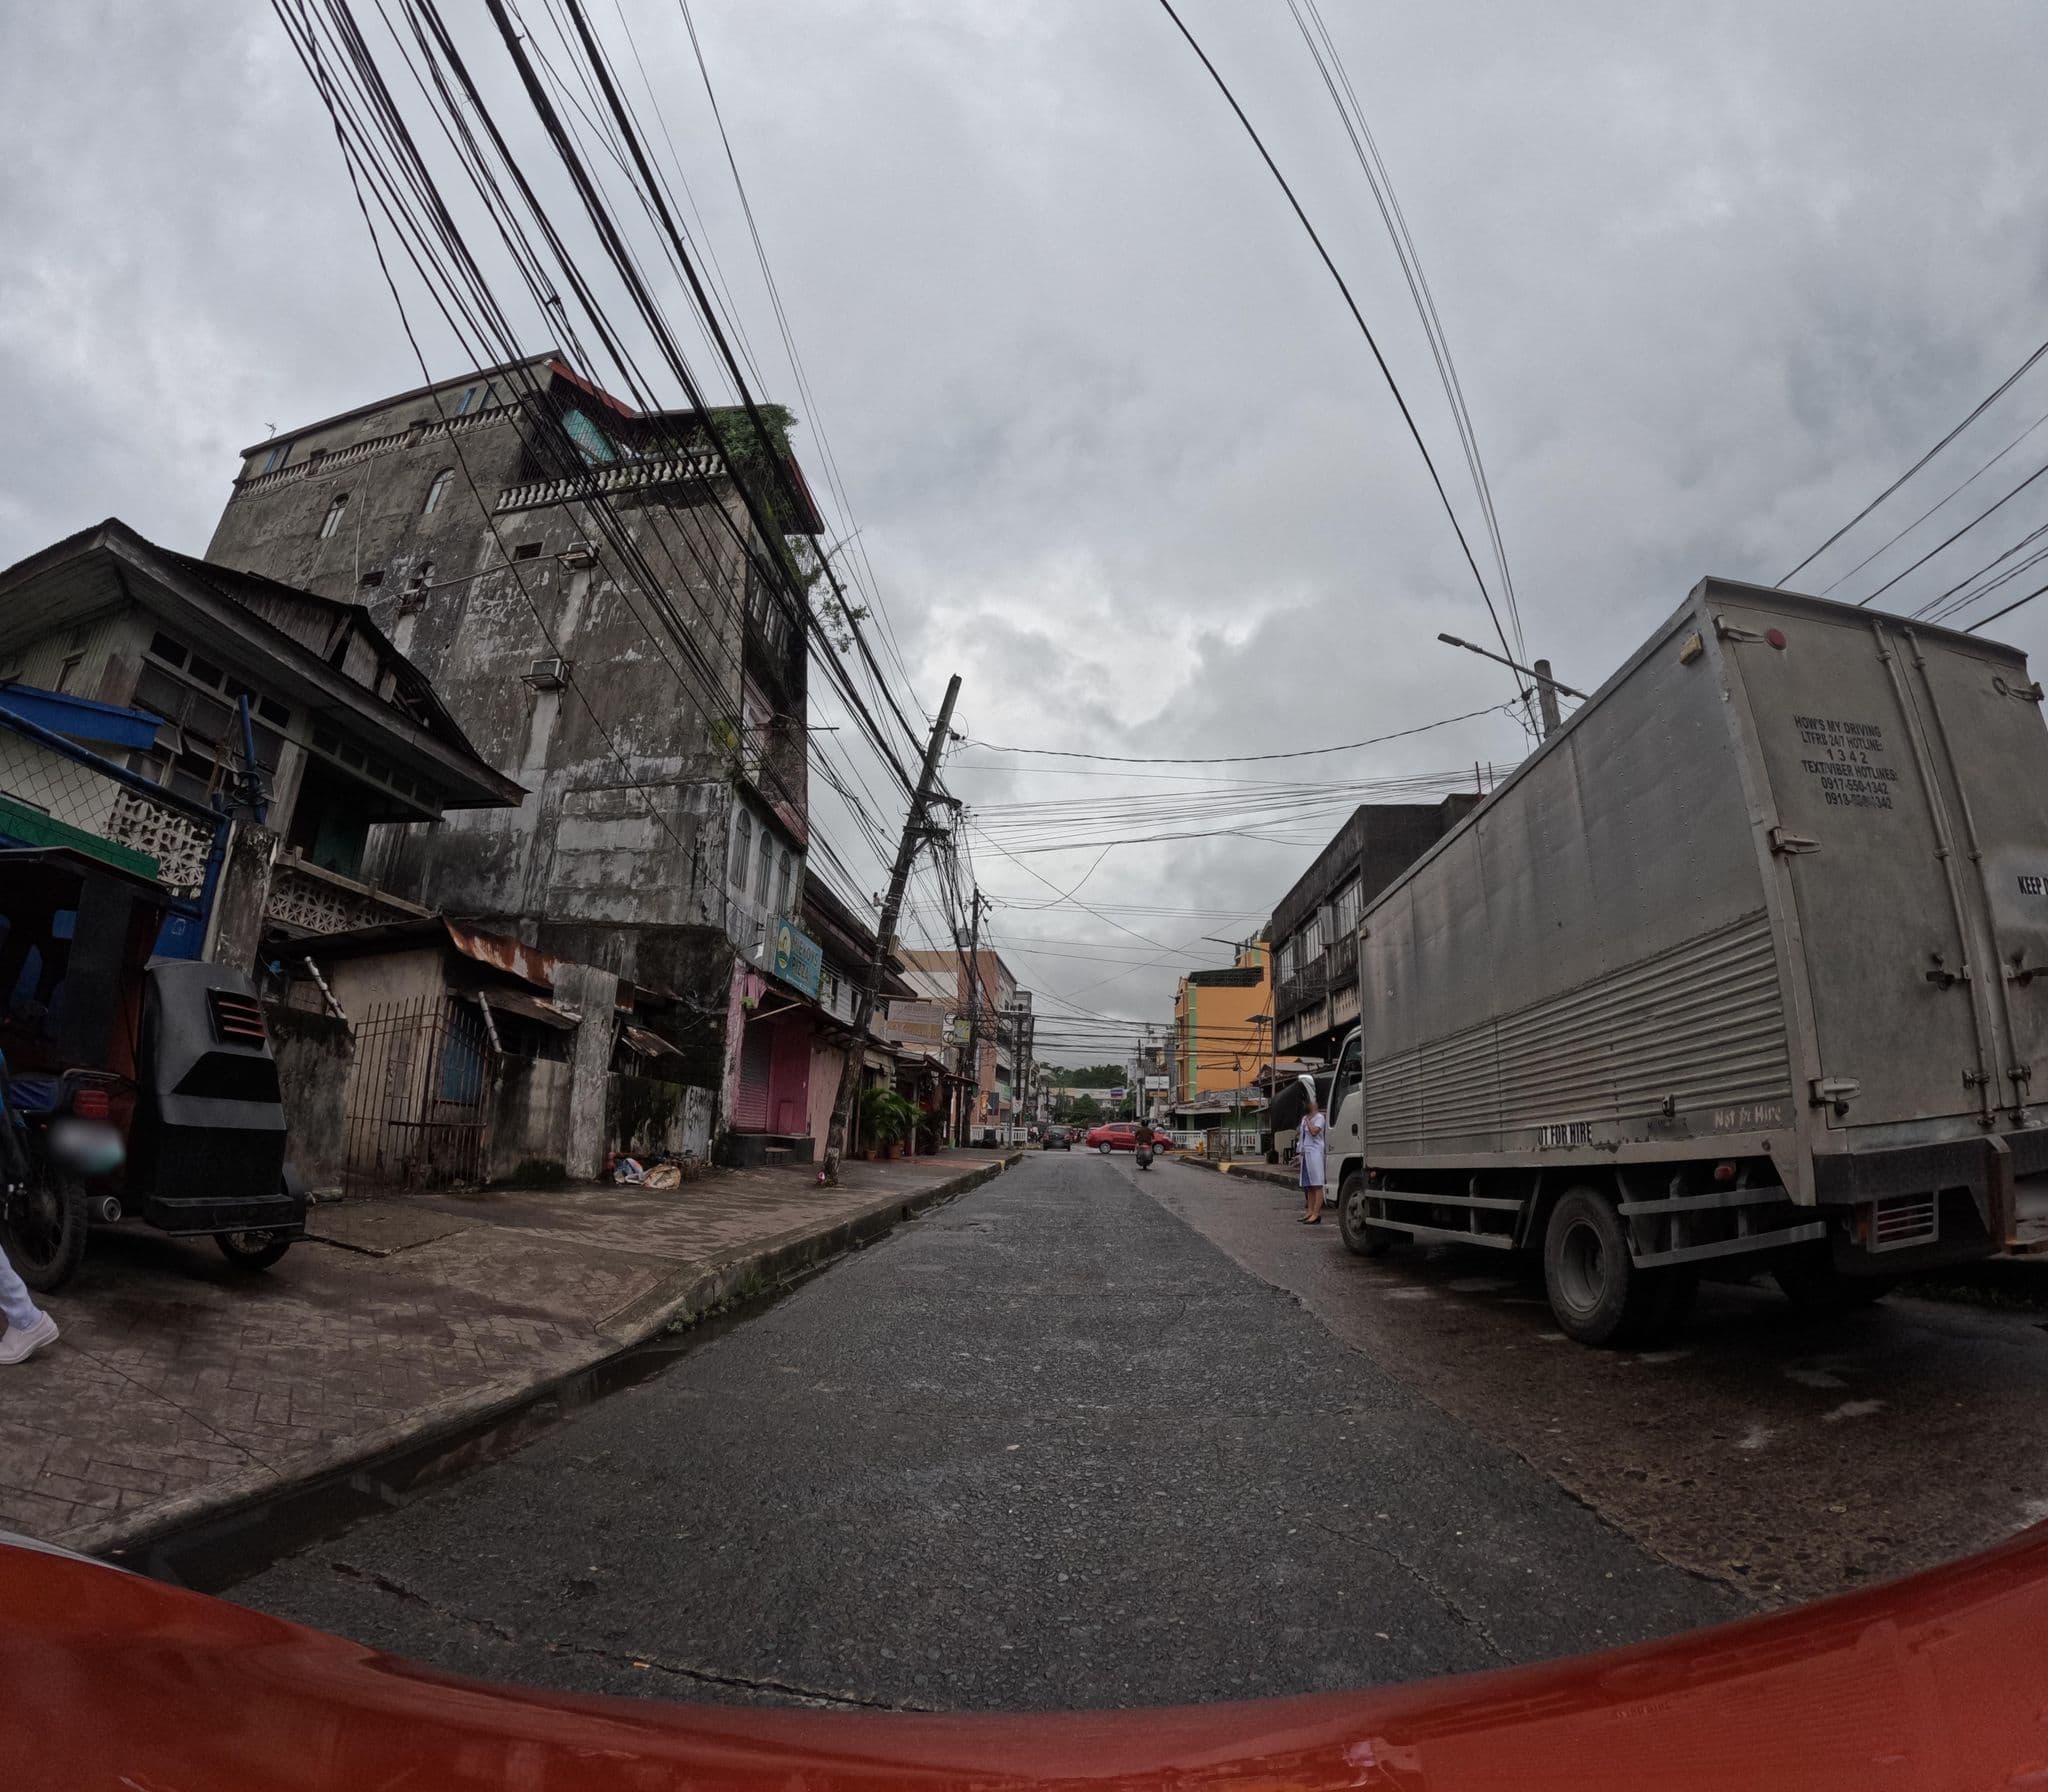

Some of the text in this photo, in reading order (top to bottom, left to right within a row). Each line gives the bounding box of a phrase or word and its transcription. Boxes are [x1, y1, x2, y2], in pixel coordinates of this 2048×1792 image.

[1794, 715, 1882, 738] HOW'S MY DRIVING
[1801, 731, 1828, 745] LTFRB
[1821, 777, 1889, 795] 0917-550-1342
[2017, 876, 2042, 895] KEEP
[1550, 1123, 1568, 1144] FOR
[1569, 1121, 1593, 1144] HIRE
